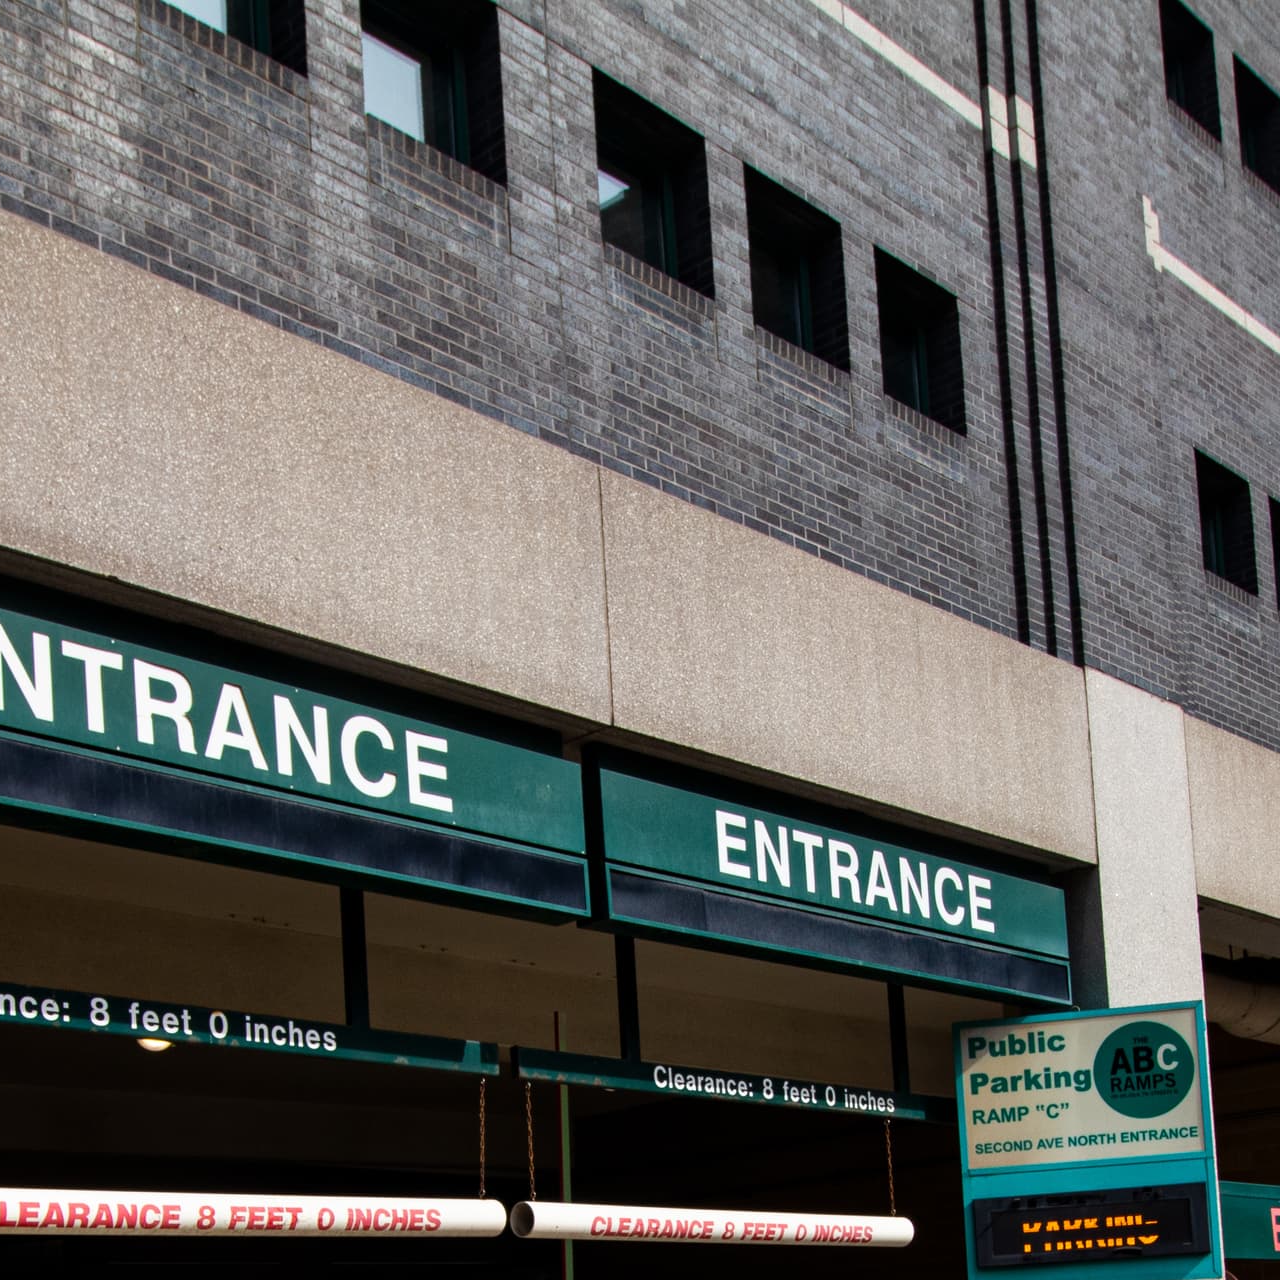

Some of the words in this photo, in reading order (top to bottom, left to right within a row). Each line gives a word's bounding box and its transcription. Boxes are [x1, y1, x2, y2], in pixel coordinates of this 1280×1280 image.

[715, 810, 996, 934] ENTRANCE
[90, 997, 110, 1028] 8
[129, 1001, 193, 1036] feet
[209, 1010, 229, 1040] 0
[245, 1015, 338, 1052] inches
[967, 1031, 1066, 1059] Public
[1133, 1036, 1149, 1044] THE
[1111, 1042, 1180, 1075] ABC
[653, 1065, 754, 1097] Clearance:
[762, 1078, 774, 1100] 8
[782, 1081, 818, 1104] feet
[825, 1085, 836, 1107] 0
[844, 1088, 896, 1113] inches
[970, 1066, 1093, 1096] Parking
[1110, 1072, 1177, 1093] RAMPS
[972, 1105, 1030, 1125] RAMP
[975, 1139, 1033, 1155] SECOND
[1036, 1137, 1064, 1150] AVE
[1068, 1133, 1116, 1148] NORTH
[1120, 1126, 1199, 1144] ENTRANCE
[196, 1205, 216, 1231] 8
[228, 1206, 303, 1231] FEET
[345, 1208, 442, 1232] INCHES
[590, 1216, 715, 1240] CLEARANCE
[721, 1221, 736, 1241] 8
[740, 1222, 788, 1242] FEET
[811, 1224, 874, 1245] INCHES
